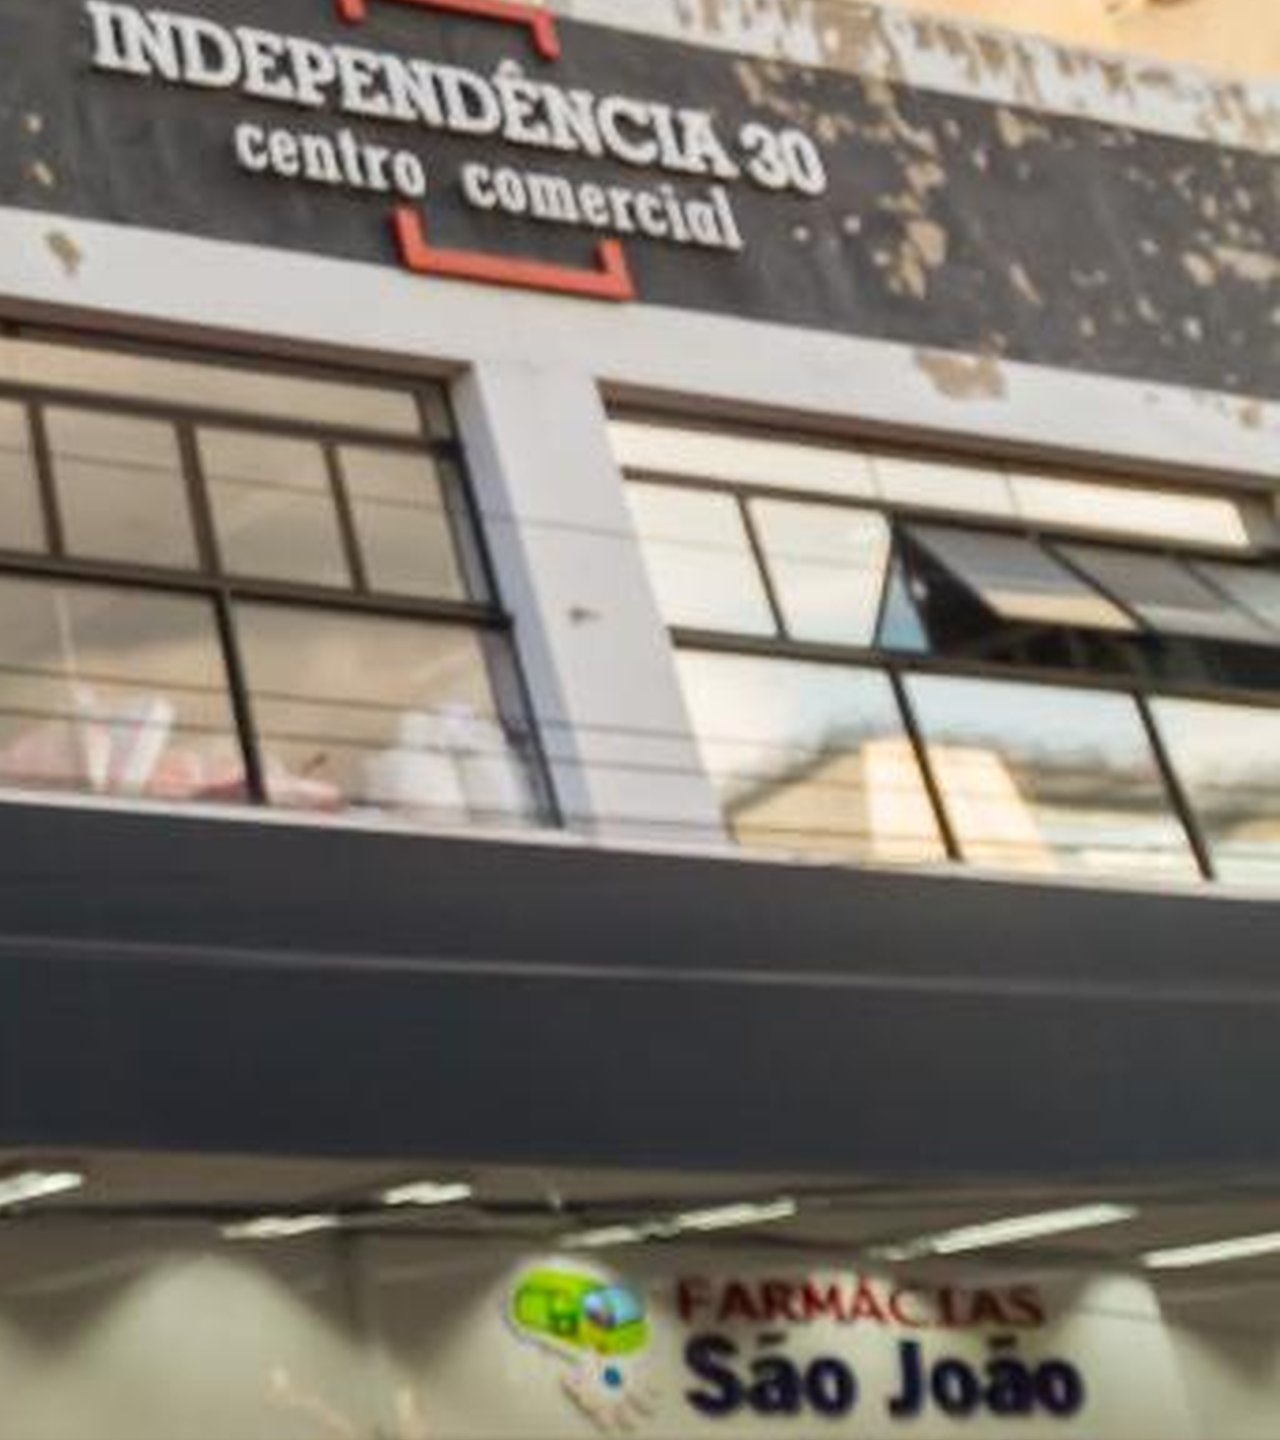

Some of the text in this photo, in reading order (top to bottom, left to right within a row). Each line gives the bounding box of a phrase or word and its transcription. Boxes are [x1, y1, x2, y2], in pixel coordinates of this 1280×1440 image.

[86, 0, 827, 196] INDEPENDÊNCIA 30
[235, 123, 743, 251] centro comercial
[677, 1271, 1048, 1328] FARMÁCIAS
[684, 1331, 1084, 1418] São João
